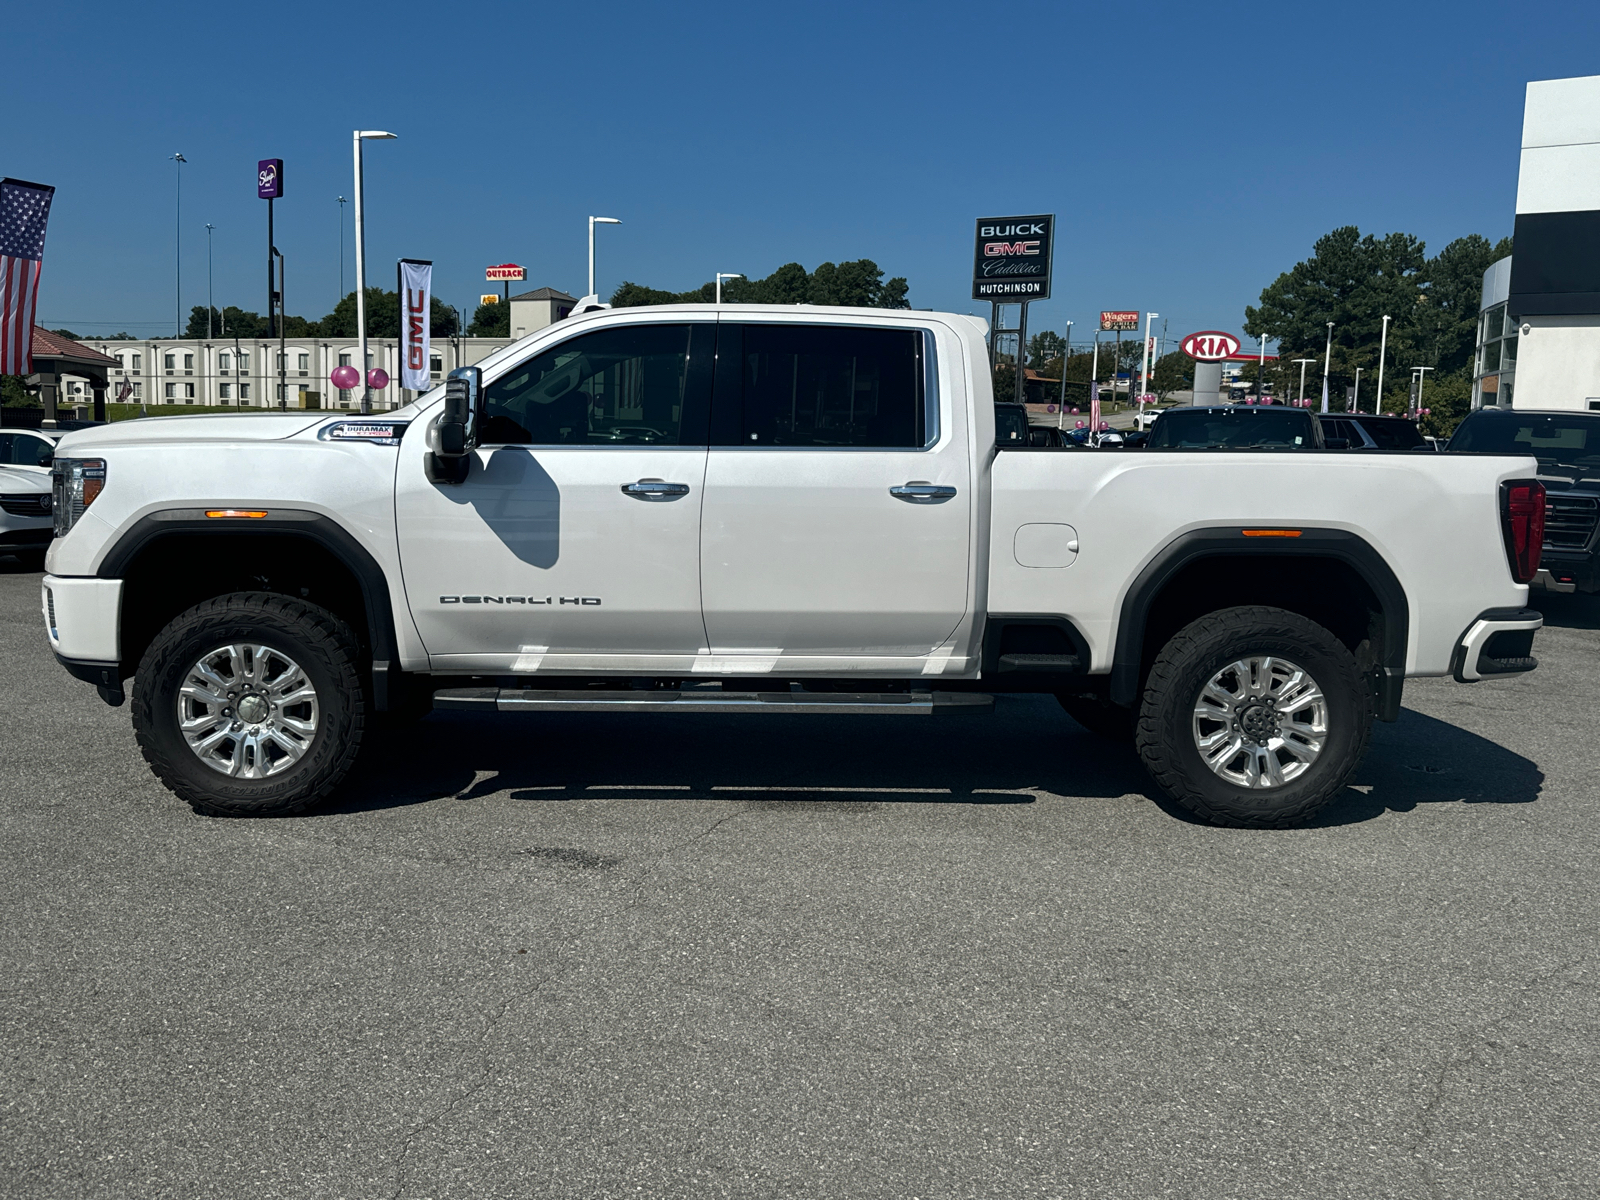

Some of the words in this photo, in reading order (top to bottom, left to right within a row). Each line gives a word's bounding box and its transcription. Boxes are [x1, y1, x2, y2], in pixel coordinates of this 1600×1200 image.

[981, 223, 1045, 237] BUICK
[984, 241, 1040, 256] GMC
[486, 270, 523, 278] OUTBACK
[982, 259, 1040, 277] Cadillac
[980, 283, 1040, 293] HUTCHINSON
[1103, 312, 1137, 322] Wagers
[408, 288, 424, 370] GMC
[1192, 338, 1230, 356] KIA
[439, 595, 552, 604] DENALI
[559, 596, 602, 605] HD
[1223, 639, 1315, 660] COUNTRY
